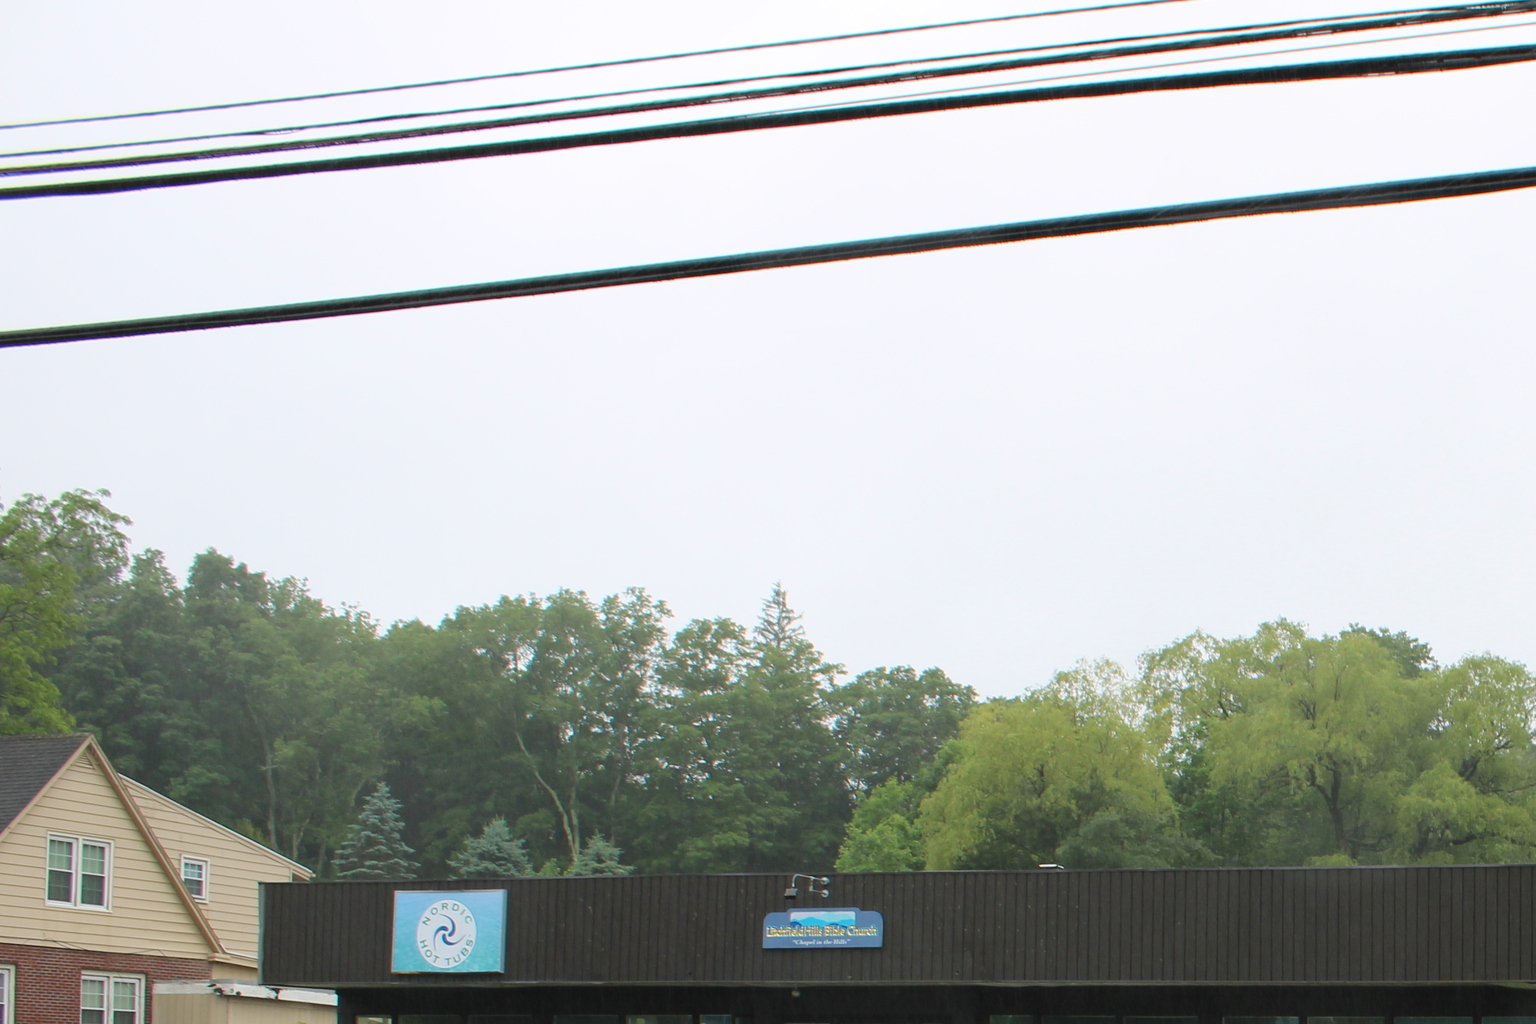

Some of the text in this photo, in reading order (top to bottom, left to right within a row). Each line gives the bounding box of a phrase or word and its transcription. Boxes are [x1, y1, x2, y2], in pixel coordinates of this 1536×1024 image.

[421, 902, 474, 927] NORDIC
[824, 925, 845, 937] Bible
[847, 925, 878, 937] Church
[419, 938, 474, 966] HOT TUBS
